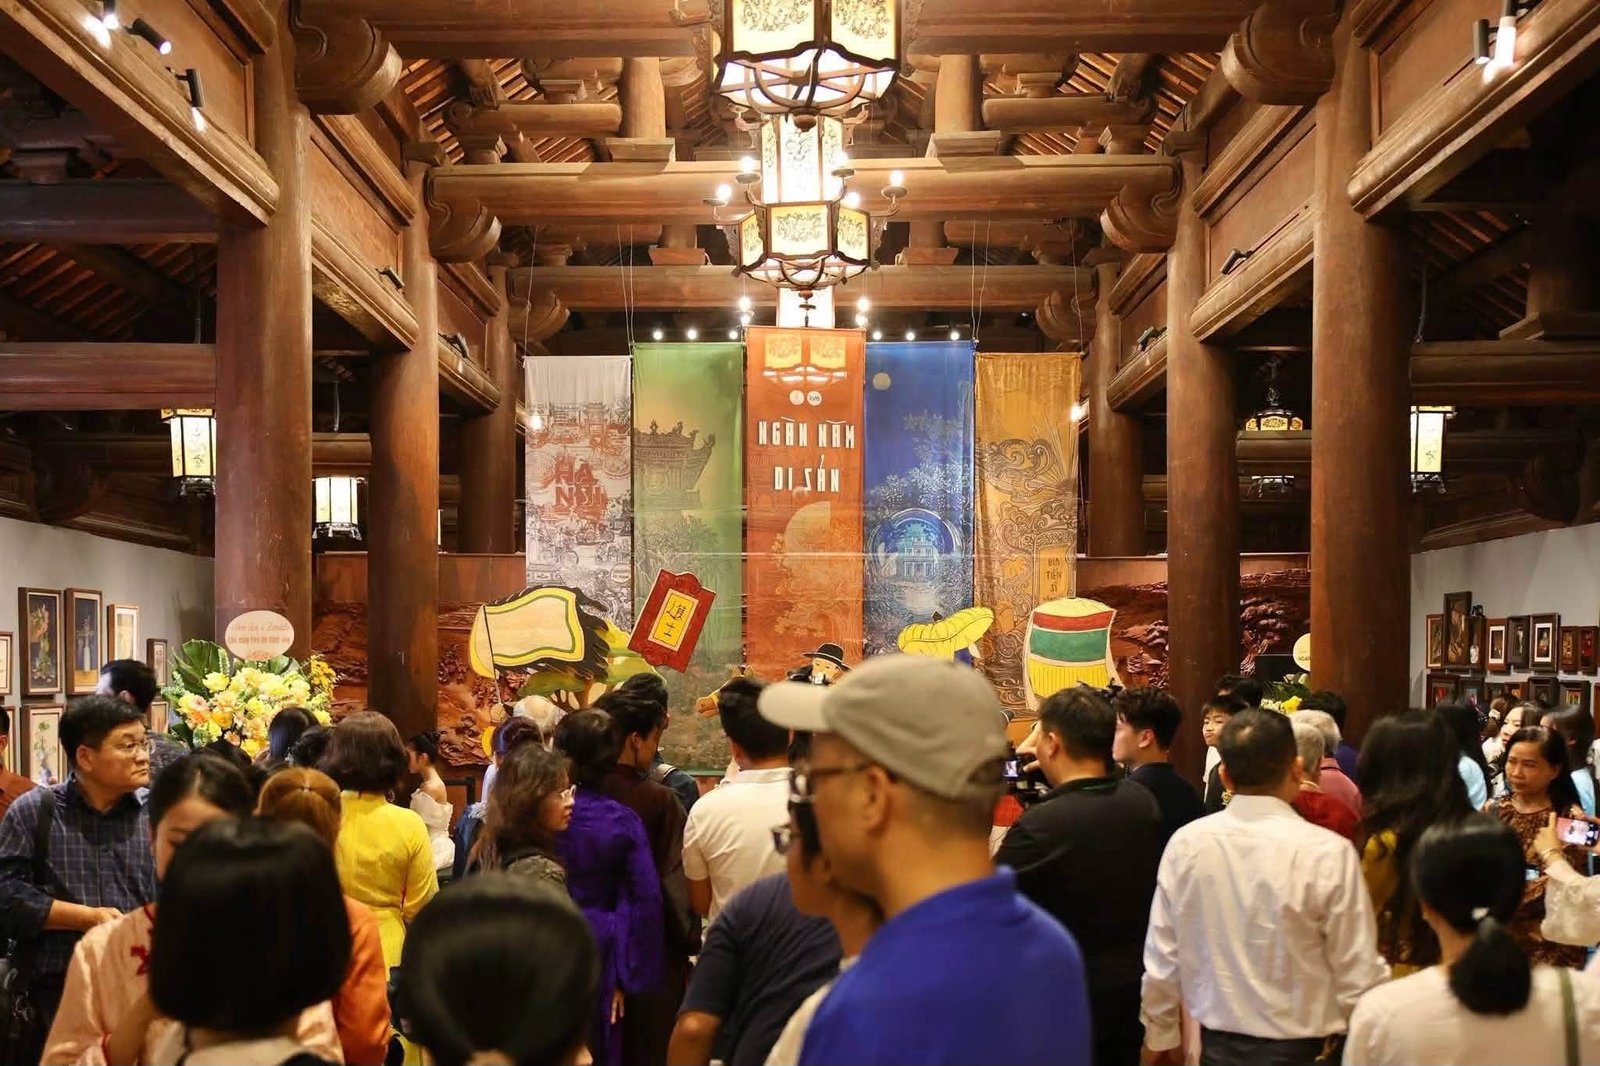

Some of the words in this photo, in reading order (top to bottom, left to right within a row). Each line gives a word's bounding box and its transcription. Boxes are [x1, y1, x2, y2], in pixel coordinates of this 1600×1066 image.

[758, 416, 808, 447] NGÀN
[818, 419, 855, 449] NĂM
[774, 466, 793, 491] DI
